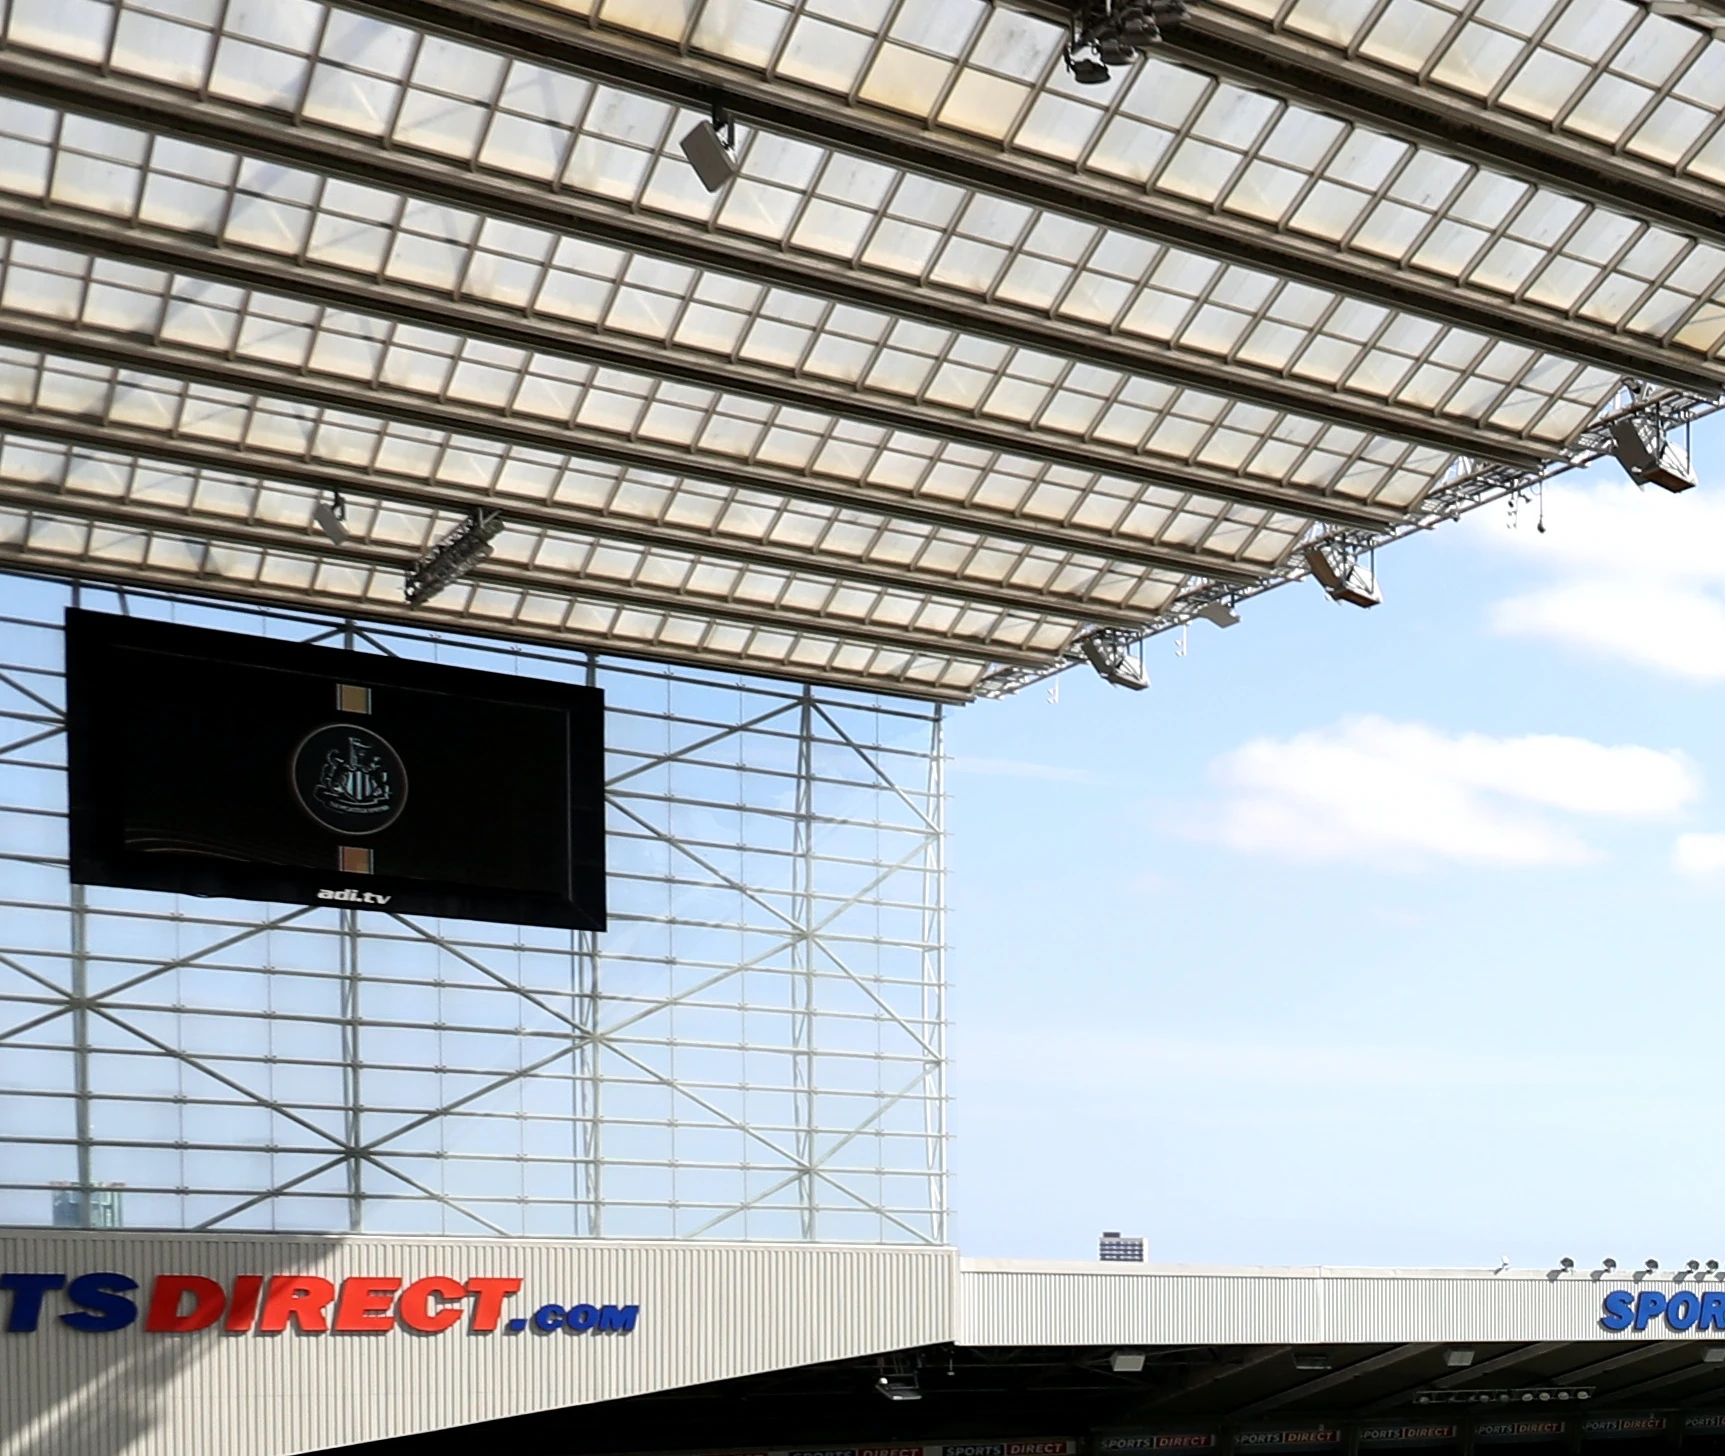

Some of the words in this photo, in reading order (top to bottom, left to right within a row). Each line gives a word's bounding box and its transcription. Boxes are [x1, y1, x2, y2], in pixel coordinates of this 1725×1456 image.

[317, 888, 392, 905] adi.tv
[1408, 1427, 1449, 1438] DIRECT
[1518, 1422, 1559, 1433] DIRECT
[1159, 1436, 1206, 1447] DIRECT
[1288, 1431, 1333, 1442] DIRECT
[946, 1445, 1002, 1456] SPORTS
[1011, 1443, 1064, 1454] DIRECT
